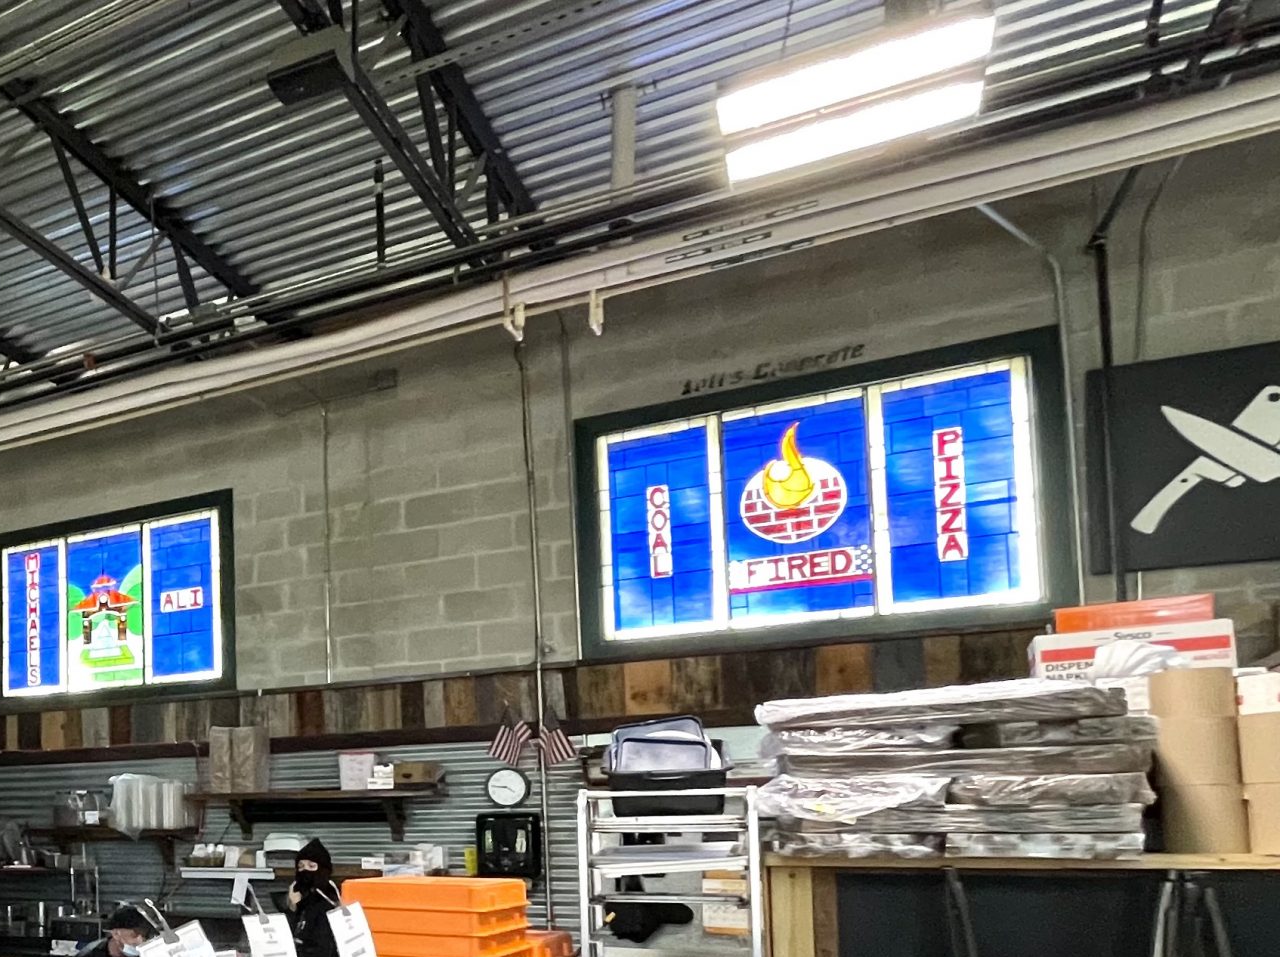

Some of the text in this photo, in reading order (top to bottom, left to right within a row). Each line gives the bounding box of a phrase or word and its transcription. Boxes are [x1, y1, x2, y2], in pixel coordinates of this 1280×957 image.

[648, 486, 670, 577] COAL
[936, 429, 966, 561] PIZZA
[163, 588, 202, 611] ALI
[746, 548, 853, 582] FIRED
[26, 553, 39, 684] MICHAELS
